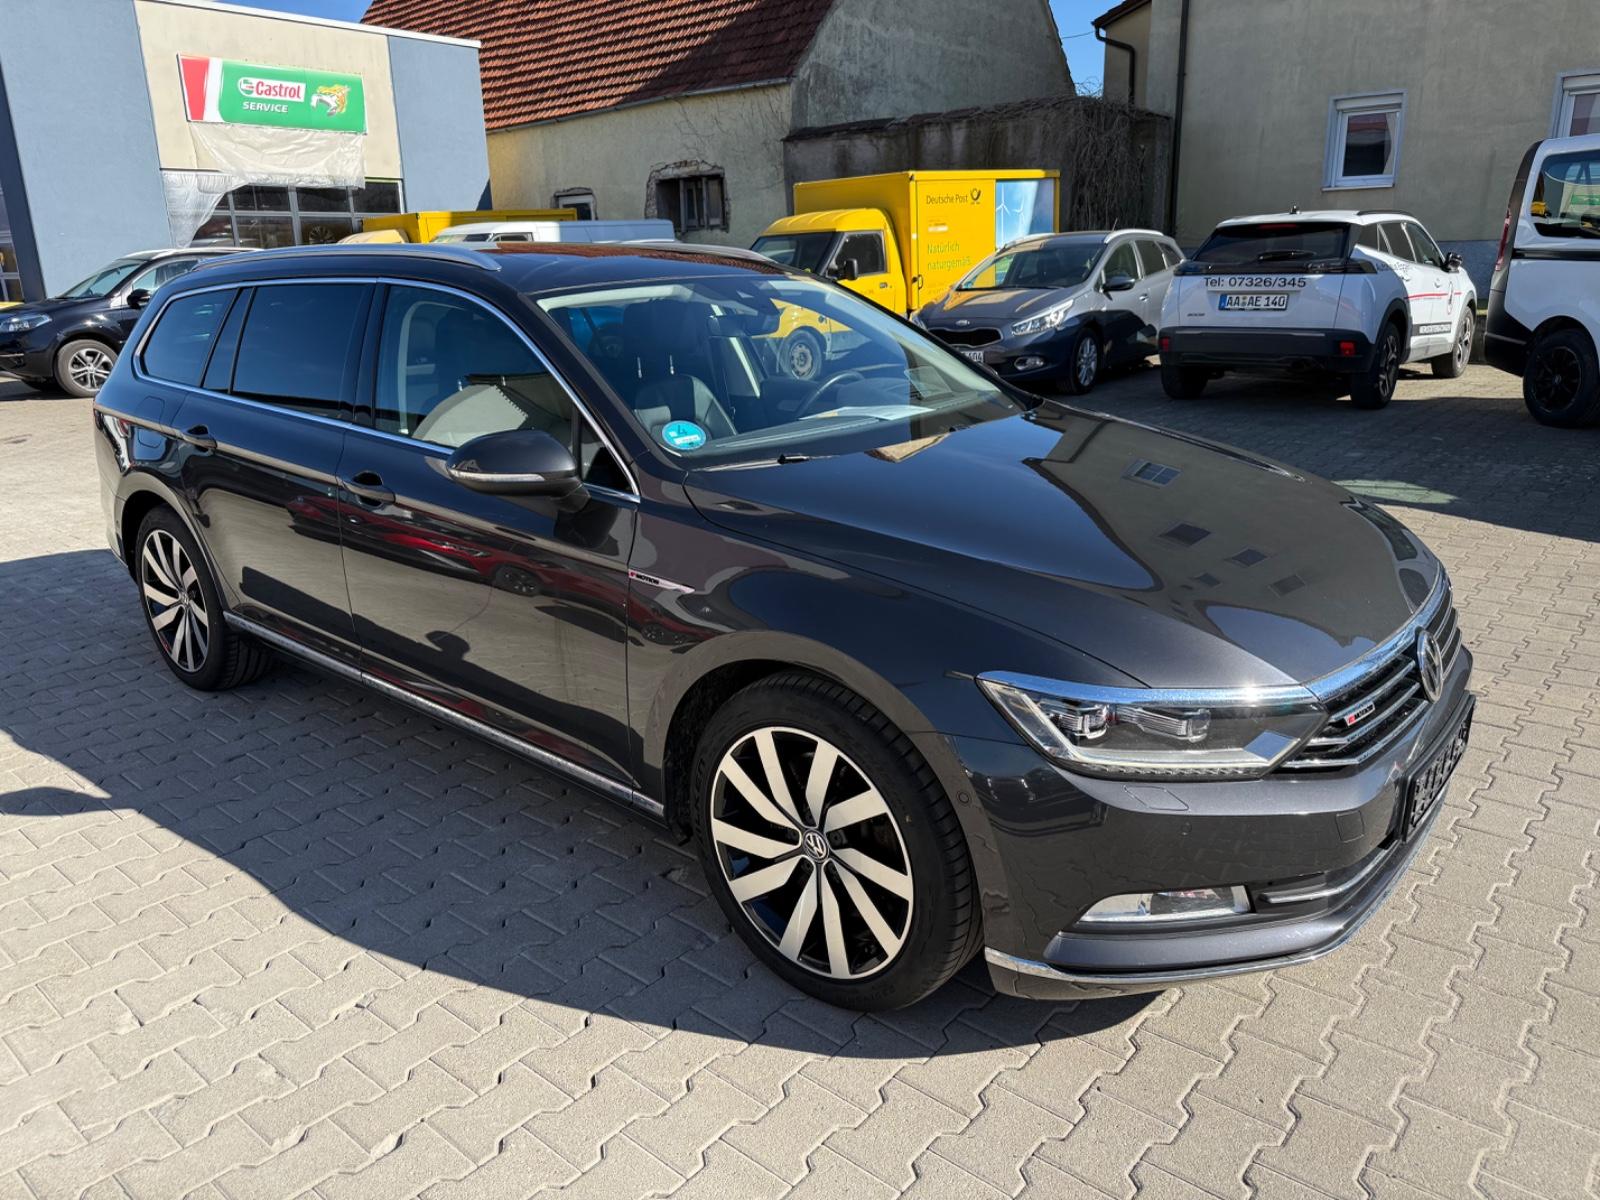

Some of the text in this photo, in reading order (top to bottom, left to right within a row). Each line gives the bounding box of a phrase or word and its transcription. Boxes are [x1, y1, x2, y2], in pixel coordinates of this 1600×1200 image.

[255, 80, 301, 99] Castrol
[242, 101, 289, 113] SERVICE
[926, 194, 968, 205] Deutsche Post
[1204, 277, 1307, 288] Tel: 07326/345
[1226, 296, 1286, 307] AA AE 140
